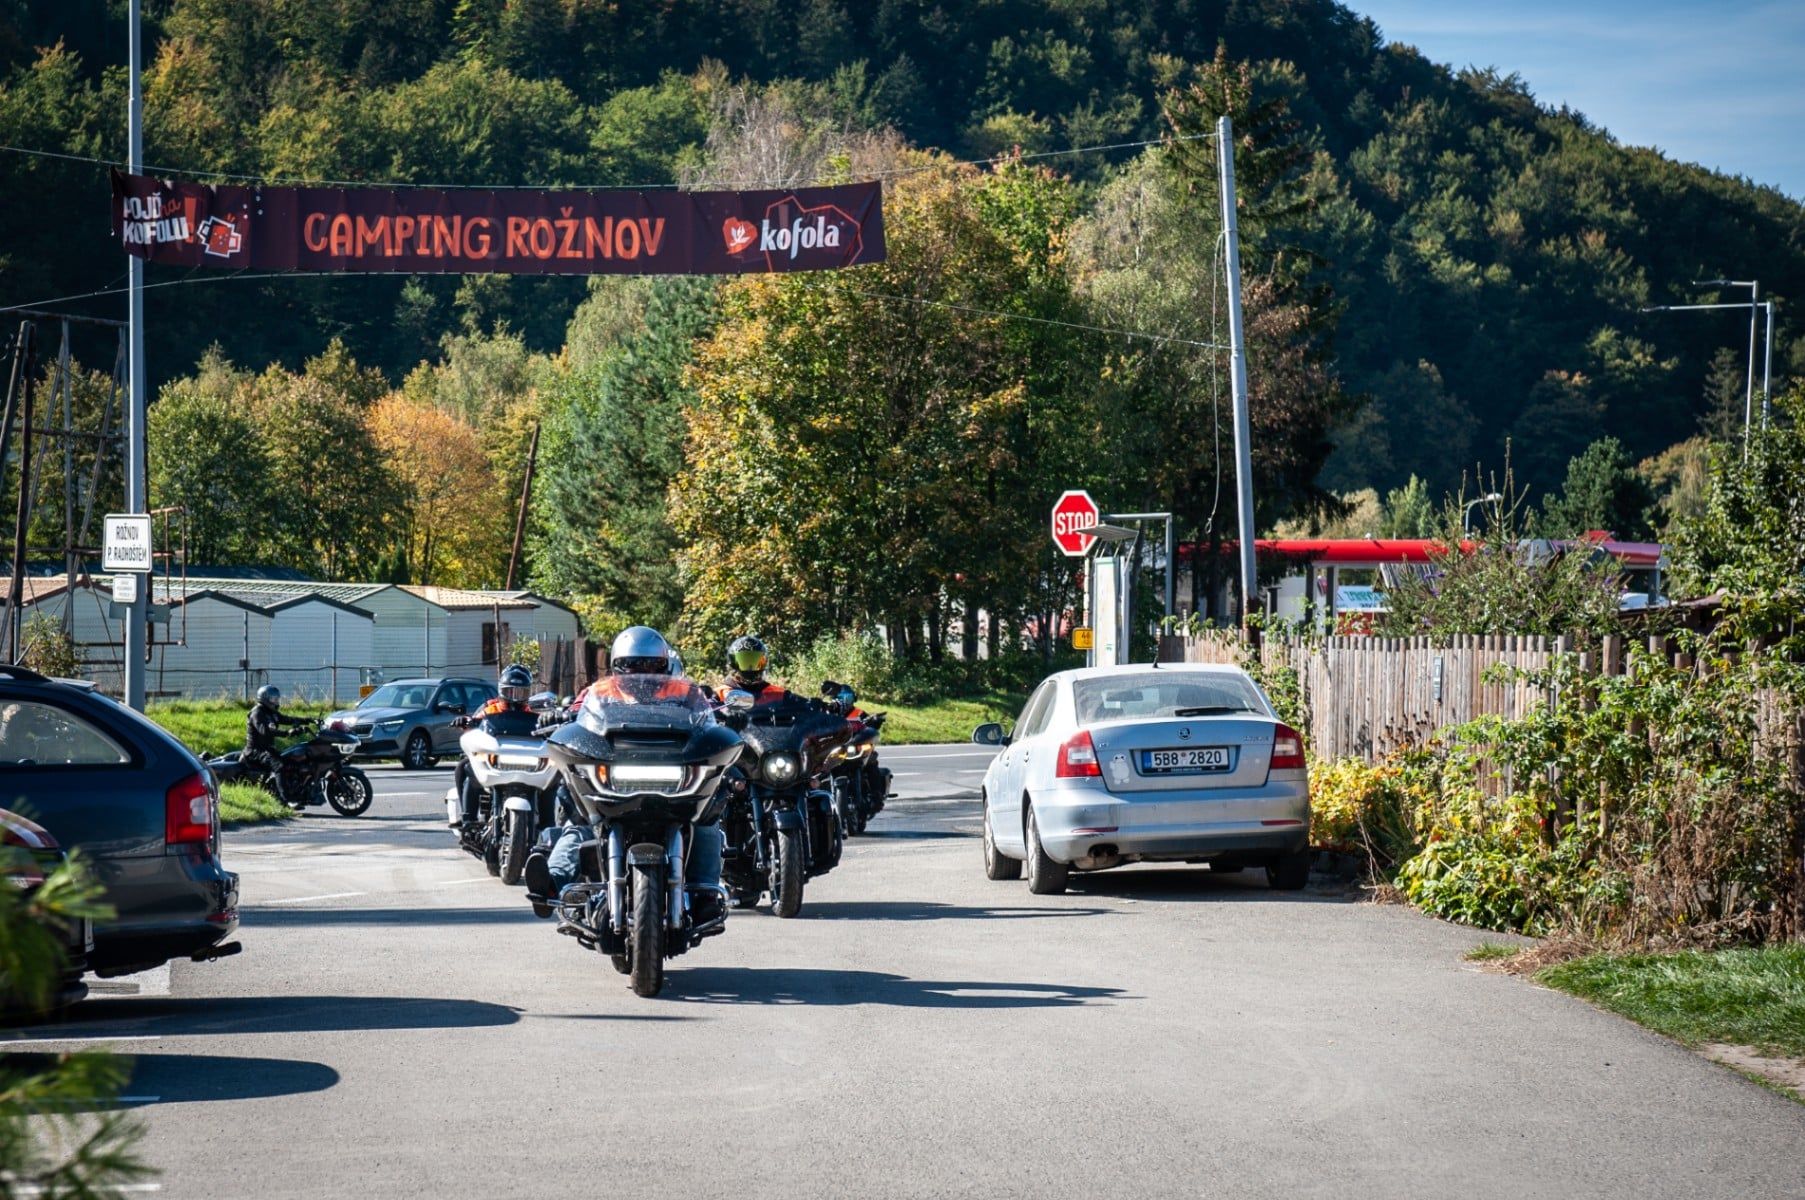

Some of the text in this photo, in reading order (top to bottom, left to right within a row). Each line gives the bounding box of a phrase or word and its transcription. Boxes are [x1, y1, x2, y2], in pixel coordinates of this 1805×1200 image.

[304, 207, 666, 260] CAMPING ROŽNOV
[760, 215, 840, 260] kofola
[116, 522, 139, 540] ROŽNOV
[1056, 511, 1094, 535] STOP
[1154, 750, 1222, 766] 5B8 2820
